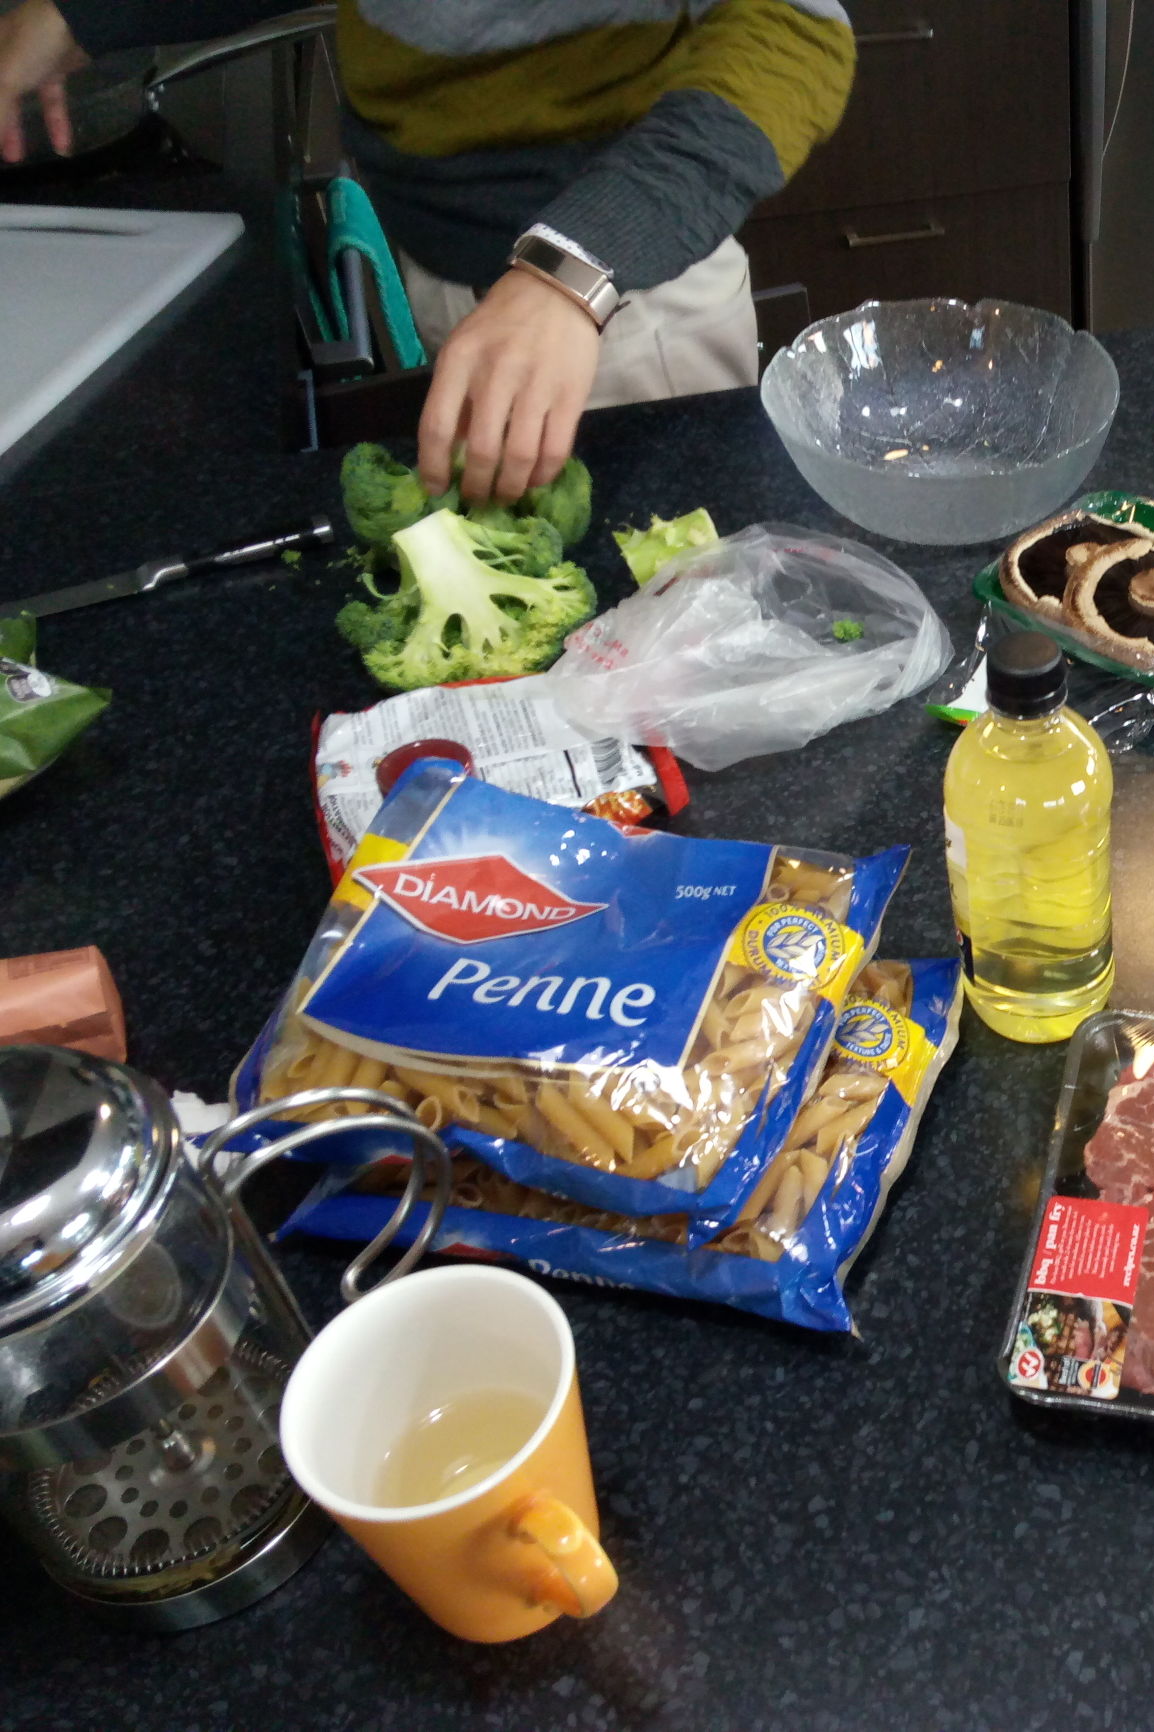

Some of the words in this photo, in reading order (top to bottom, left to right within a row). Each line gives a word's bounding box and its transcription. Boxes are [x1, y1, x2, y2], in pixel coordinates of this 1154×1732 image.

[393, 873, 576, 921] DIAMOND
[675, 884, 712, 899] 500g
[713, 884, 737, 897] NET
[780, 917, 819, 933] PERFECT
[427, 957, 656, 1027] Penne
